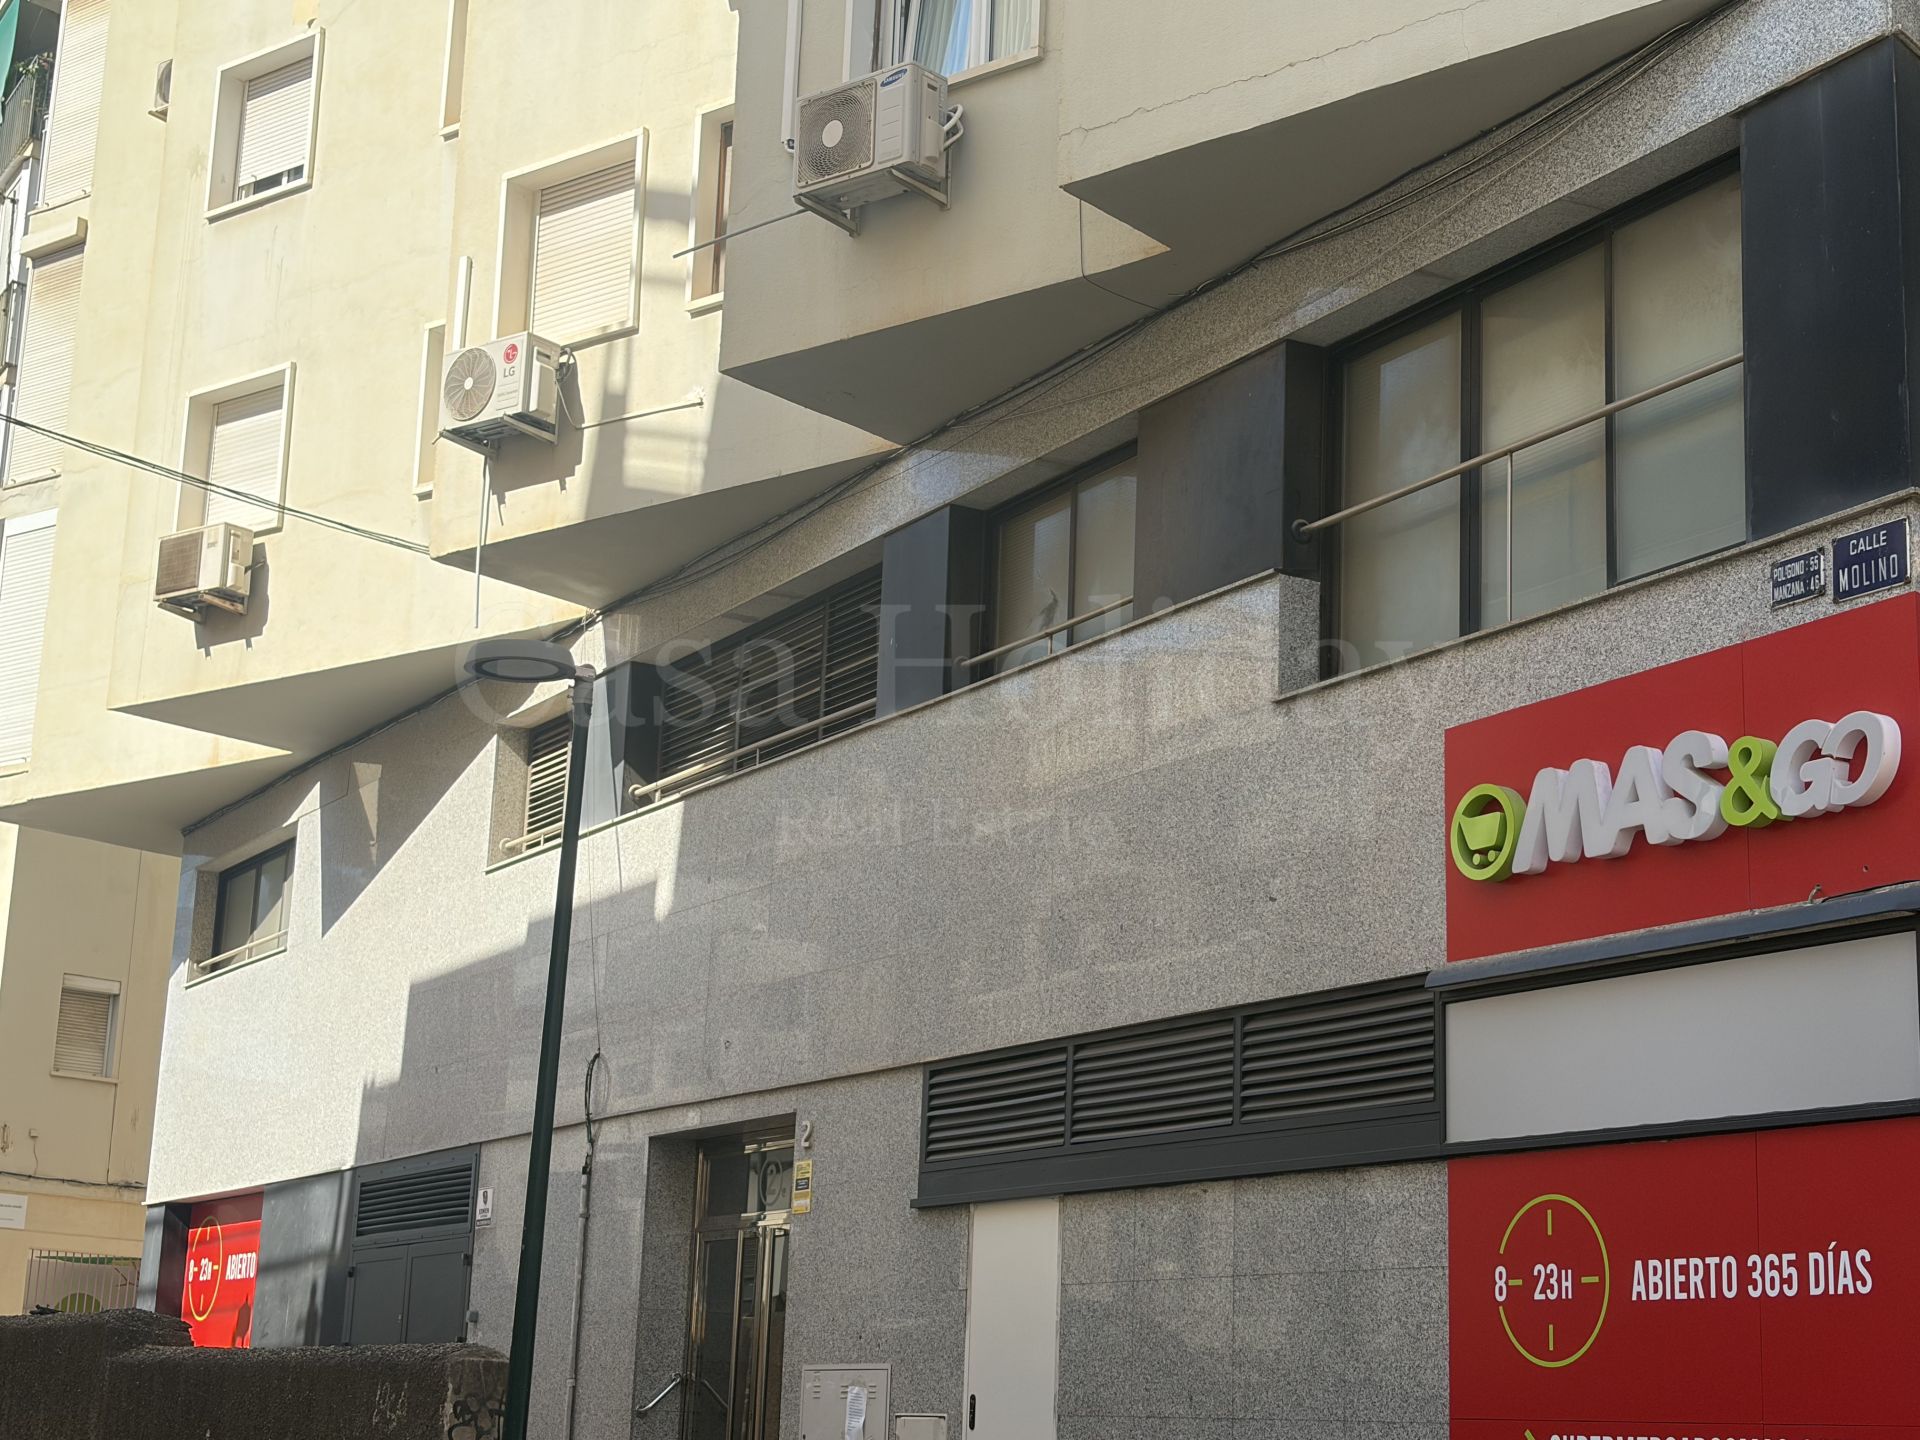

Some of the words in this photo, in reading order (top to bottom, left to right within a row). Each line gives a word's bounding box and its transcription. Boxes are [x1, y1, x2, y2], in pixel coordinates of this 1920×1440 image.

[503, 366, 516, 378] LG
[1849, 530, 1888, 555] CALLE
[1809, 555, 1819, 572] 55
[1839, 554, 1898, 593] MOLINO
[1773, 580, 1805, 601] MANZANA
[1810, 574, 1820, 592] 46
[1512, 710, 1902, 875] MAS&GO
[801, 1120, 811, 1147] 2
[225, 1251, 257, 1281] ABIERTO
[1631, 1255, 1738, 1301] ABIERTO
[1747, 1253, 1799, 1299] 365
[1808, 1241, 1873, 1296] DÍAS
[1494, 1265, 1507, 1302] 8
[1533, 1263, 1573, 1300] 23H
